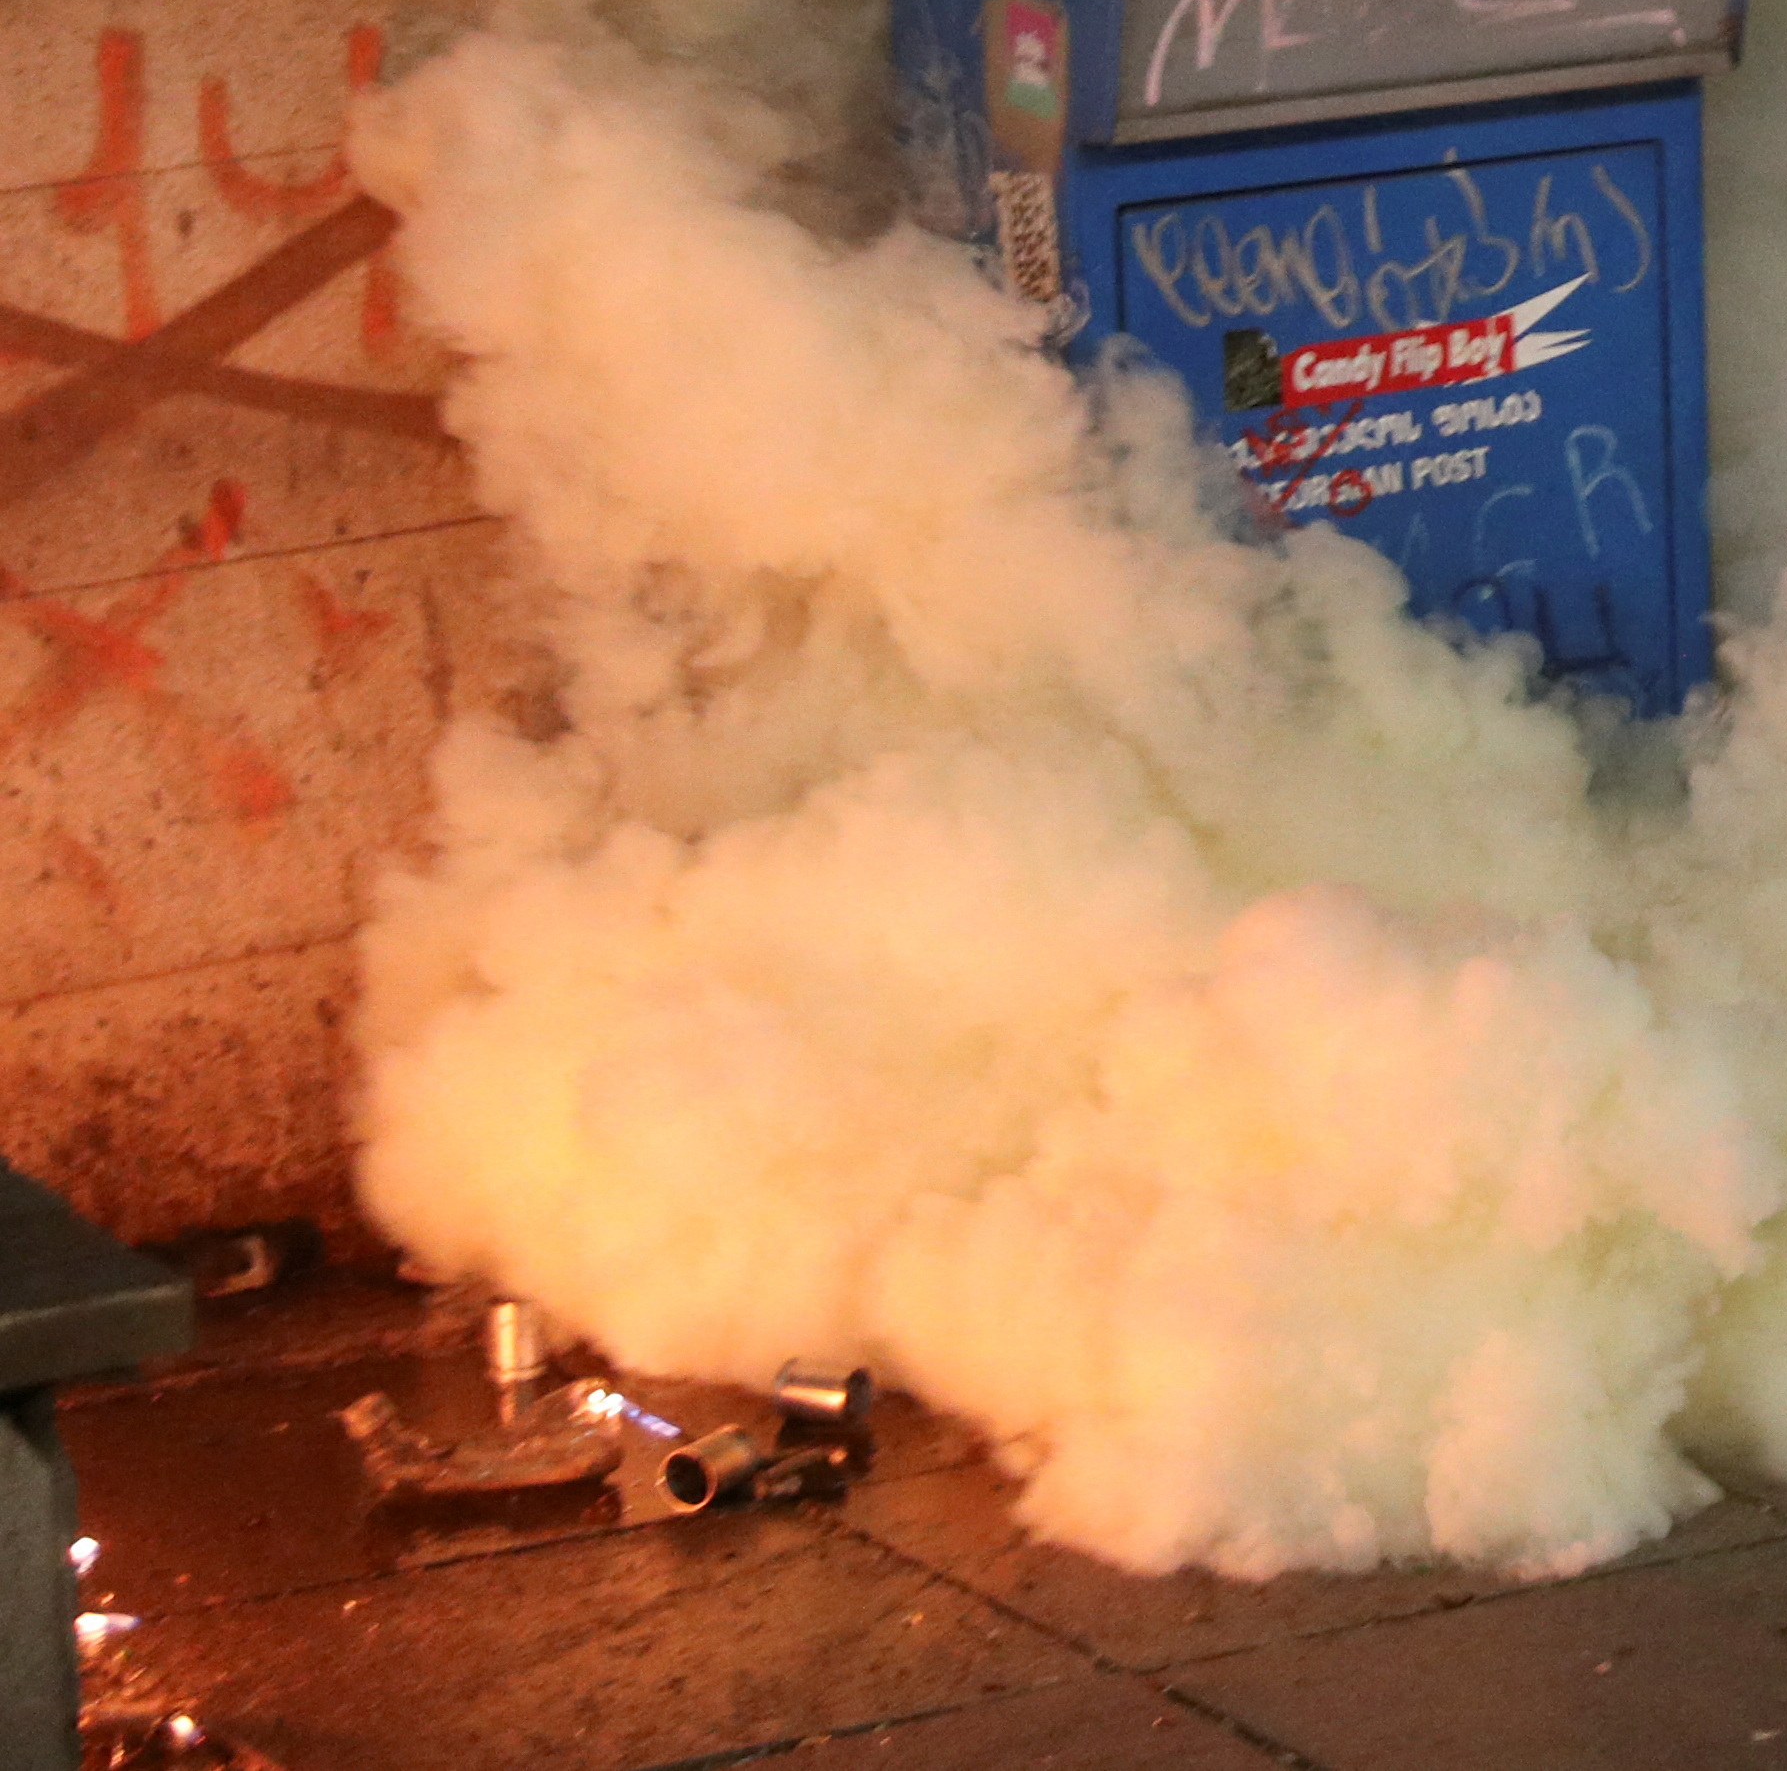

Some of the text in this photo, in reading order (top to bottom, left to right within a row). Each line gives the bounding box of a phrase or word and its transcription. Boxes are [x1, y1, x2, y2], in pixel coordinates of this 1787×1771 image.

[1292, 326, 1508, 392] Candy Flip Boy
[1411, 447, 1491, 491] POST
